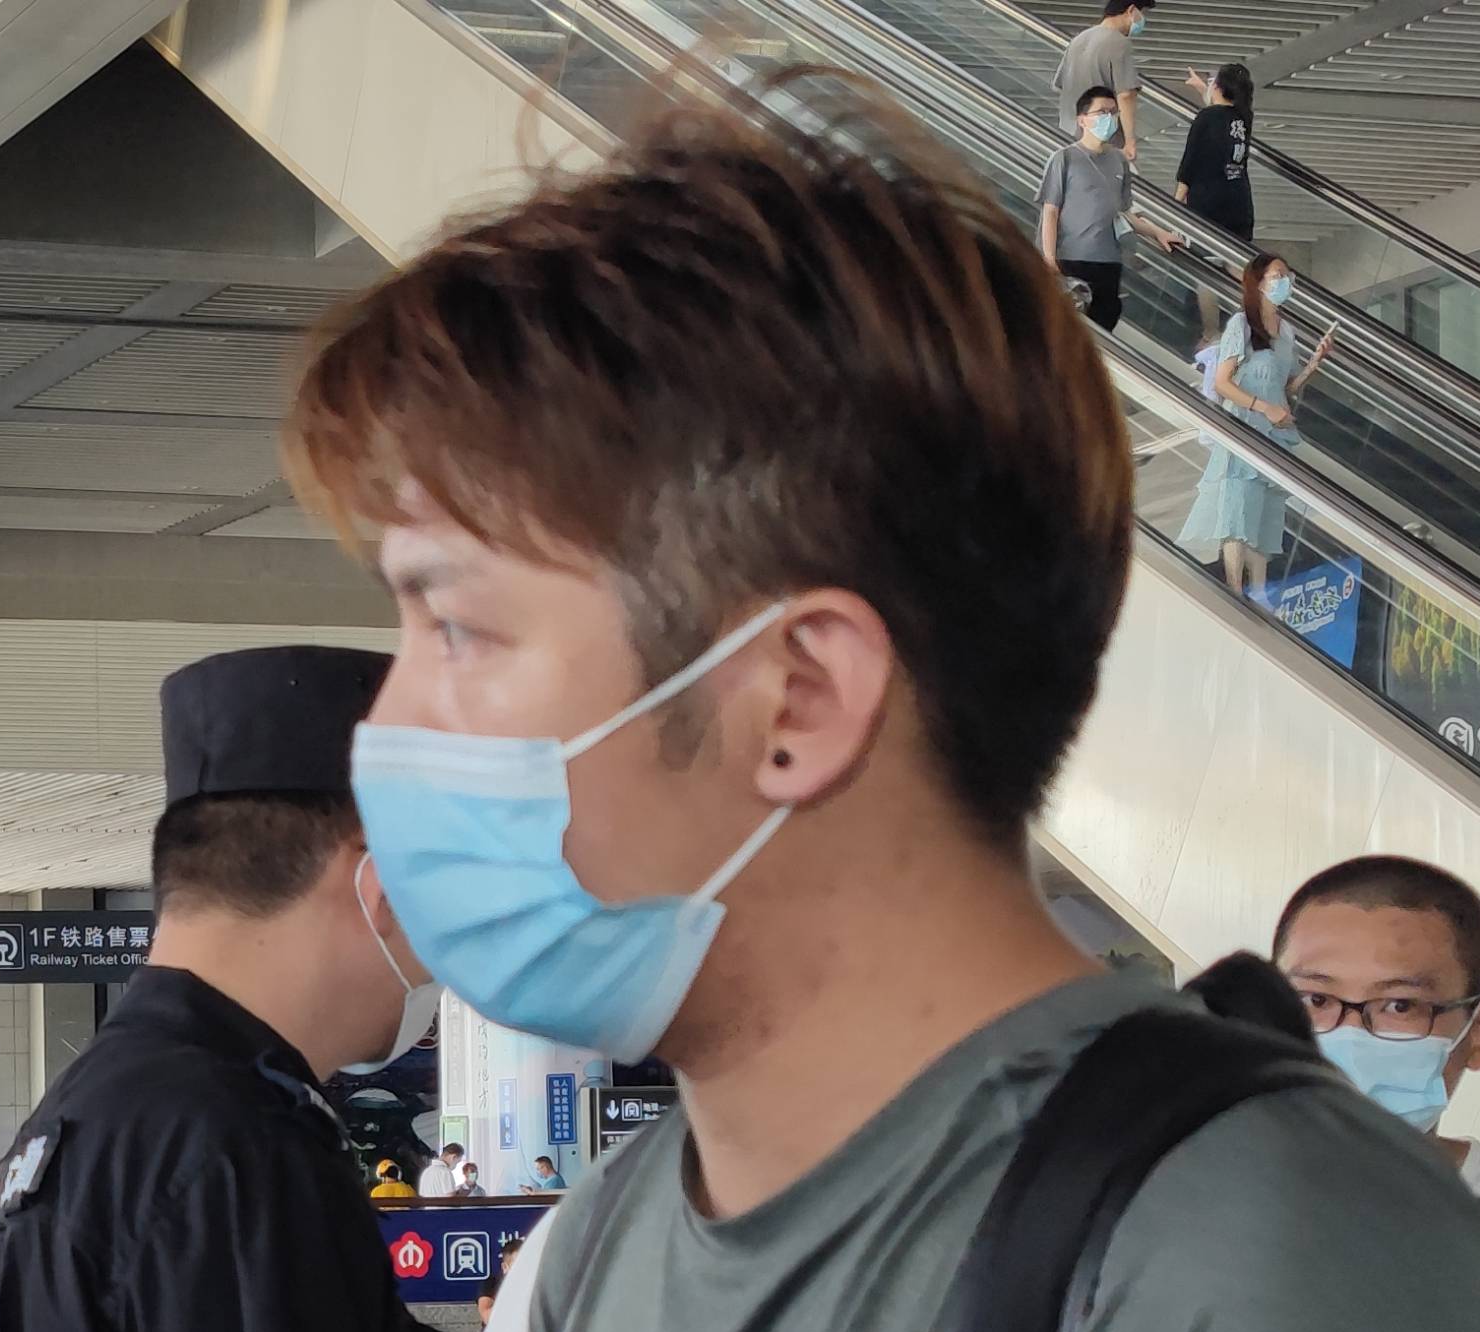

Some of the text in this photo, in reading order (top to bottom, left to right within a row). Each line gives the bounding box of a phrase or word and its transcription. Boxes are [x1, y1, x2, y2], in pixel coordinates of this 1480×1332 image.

[30, 953, 149, 968] Railway Ticket Offic
